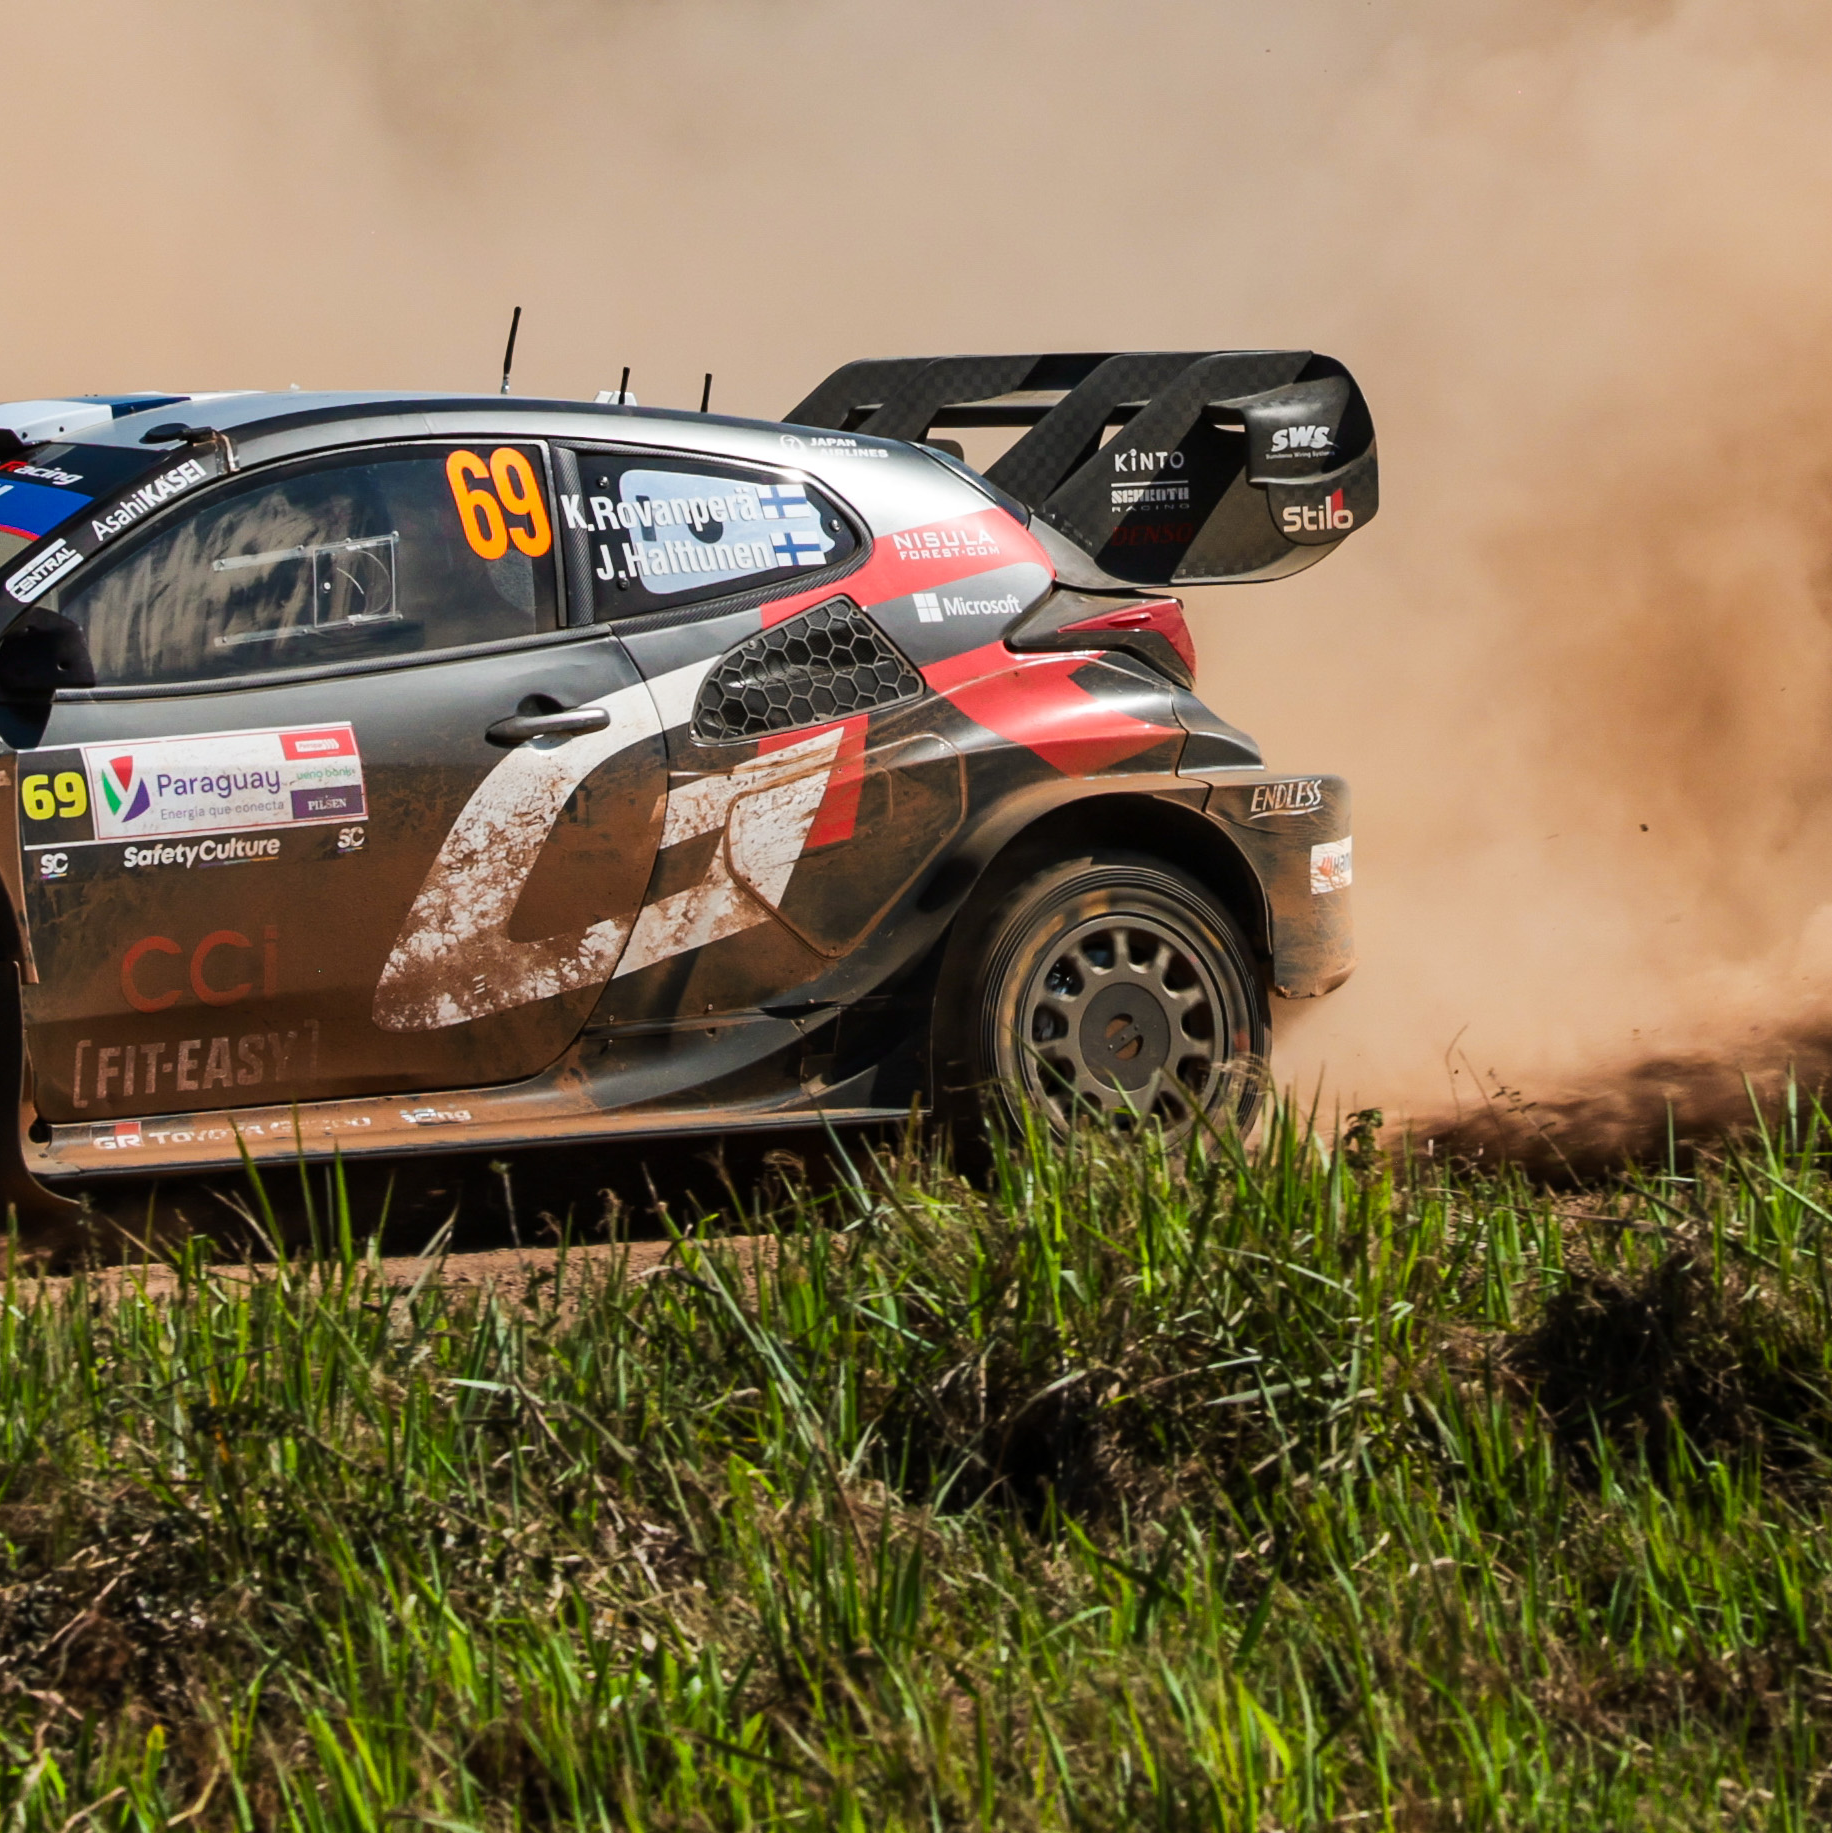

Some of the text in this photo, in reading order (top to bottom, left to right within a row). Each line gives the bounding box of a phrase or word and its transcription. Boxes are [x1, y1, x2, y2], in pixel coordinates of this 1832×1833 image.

[810, 437, 857, 447] JAPAN
[819, 448, 889, 458] AIRLINES
[1271, 425, 1330, 453] SWS
[91, 458, 207, 542] AsahiKASEI
[445, 447, 552, 560] 69
[560, 486, 756, 532] K.Rovanperä
[1282, 496, 1354, 533] Stilo
[892, 529, 995, 550] NISULA
[596, 537, 772, 581] J.Halttunen
[944, 594, 1023, 618] Microsoft
[22, 771, 88, 820] 69
[157, 770, 282, 798] Paraguay
[1251, 779, 1323, 812] ENDLESS
[208, 806, 231, 818] que
[234, 800, 285, 814] conecta
[307, 798, 347, 811] PILSEN
[337, 826, 365, 848] SC
[40, 852, 68, 874] SC
[123, 835, 280, 869] SafetyCulture
